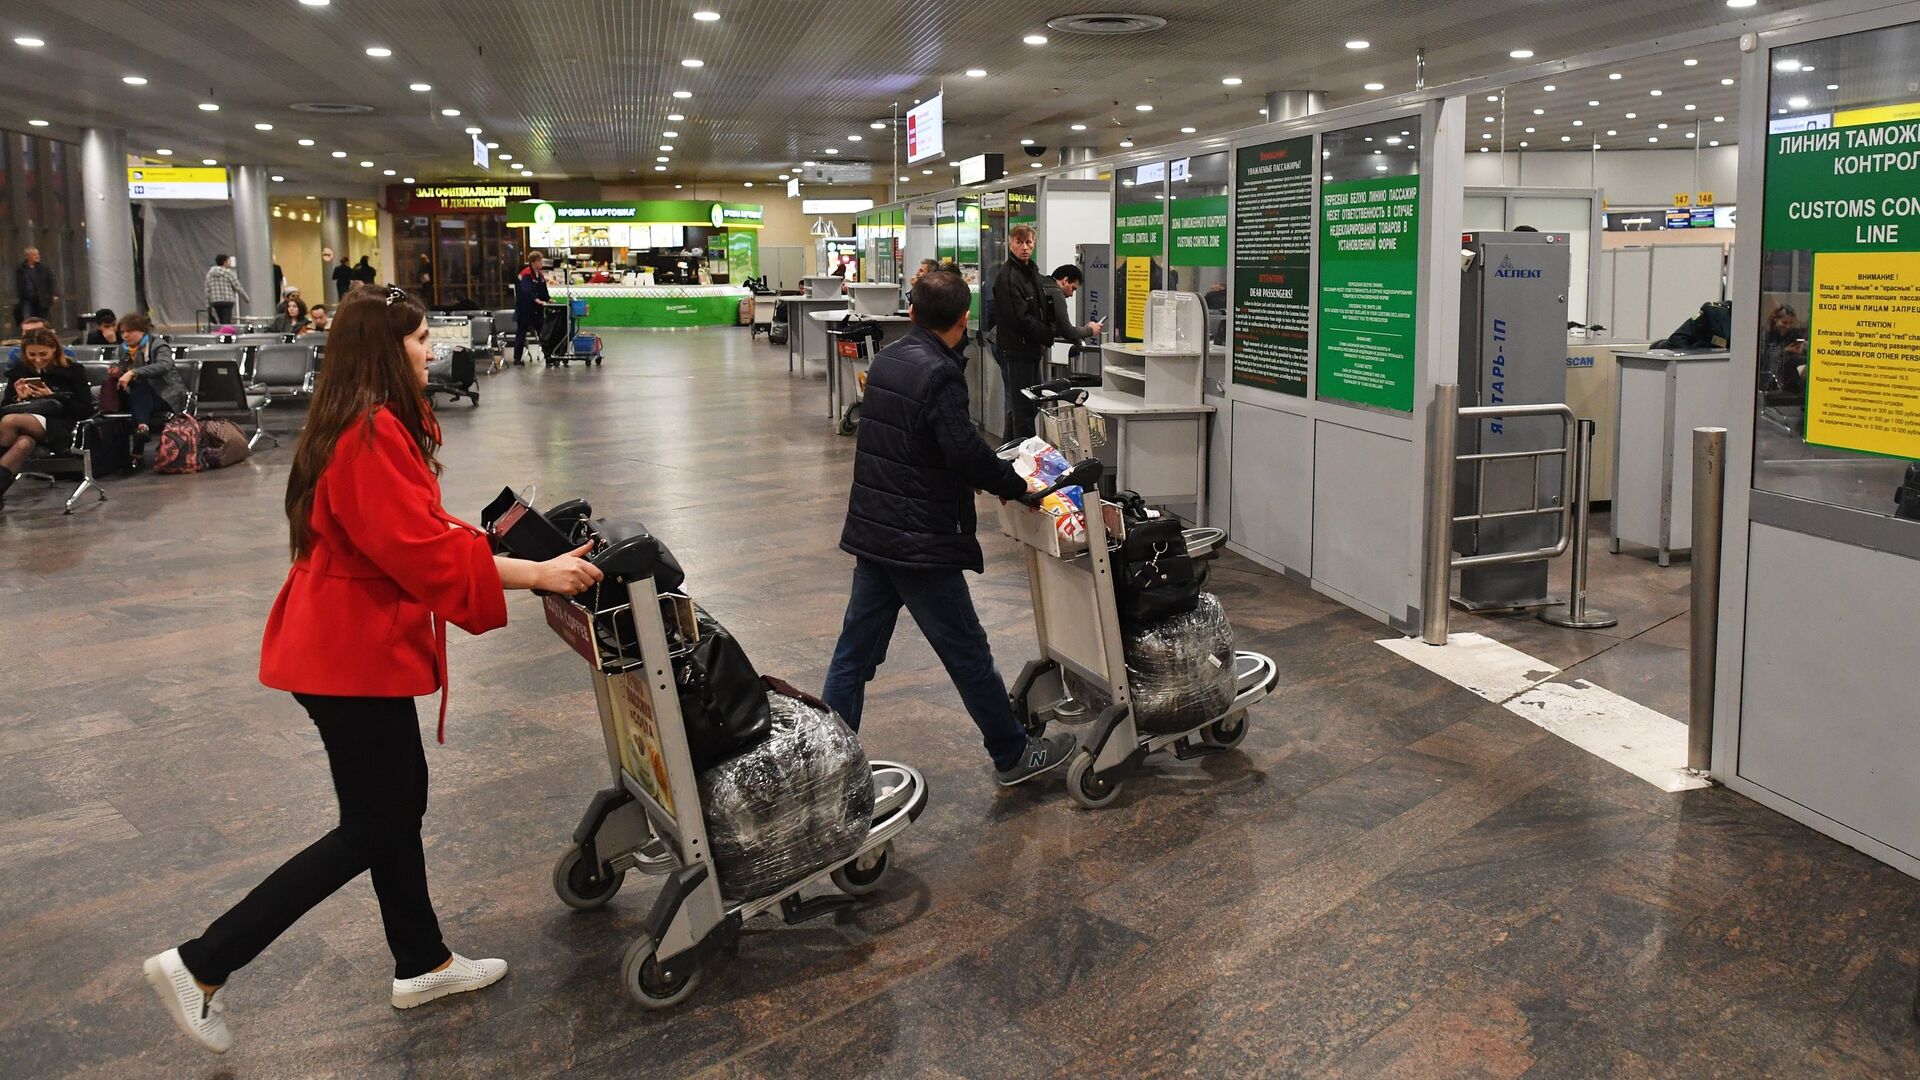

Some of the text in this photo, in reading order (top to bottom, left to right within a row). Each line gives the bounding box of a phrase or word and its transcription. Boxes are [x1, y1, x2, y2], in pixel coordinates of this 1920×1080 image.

[1779, 124, 1920, 154] ЛИНИЯ ТАМОЖ
[1248, 164, 1272, 176] УВАЖАЕМЫЕ
[416, 186, 531, 198] ЗАЛ ОФИЦИАЛЬНЫХ ЛИЦ
[1324, 187, 1416, 206] ПЕРЕСЕКАЯ БЕЛУЮ ЛИНИЮ ПАССАЖИР
[441, 196, 506, 208] И ДЕЛЕГАЦИЙ
[1676, 196, 1688, 204] 147
[1698, 195, 1712, 203] 148
[558, 208, 590, 216] КРОШКА
[1327, 205, 1413, 221] НЕСЕТ ОТВЕТСТВЕННОСТЬ В СЛУЧАЕ
[1789, 199, 1875, 219] CUSTOMS
[1330, 221, 1407, 237] НЕДЕКЛАРИРОВАНИЯ ТОВАРОВ В
[1856, 224, 1898, 243] LINE
[1122, 234, 1135, 243] CUSTOMS
[1136, 233, 1148, 243] CONTROL
[1177, 236, 1220, 247] CUSTOMS CONTROL ZONE
[1338, 236, 1396, 250] УСТАНОВЛЕННОЙ ФОРМЕ
[1494, 270, 1543, 278] АСПЕКТ
[1250, 288, 1293, 299] DEAR PASSENGERS!
[1853, 341, 1887, 349] departuring
[1566, 356, 1594, 366] SCAN
[1029, 750, 1046, 767] N
